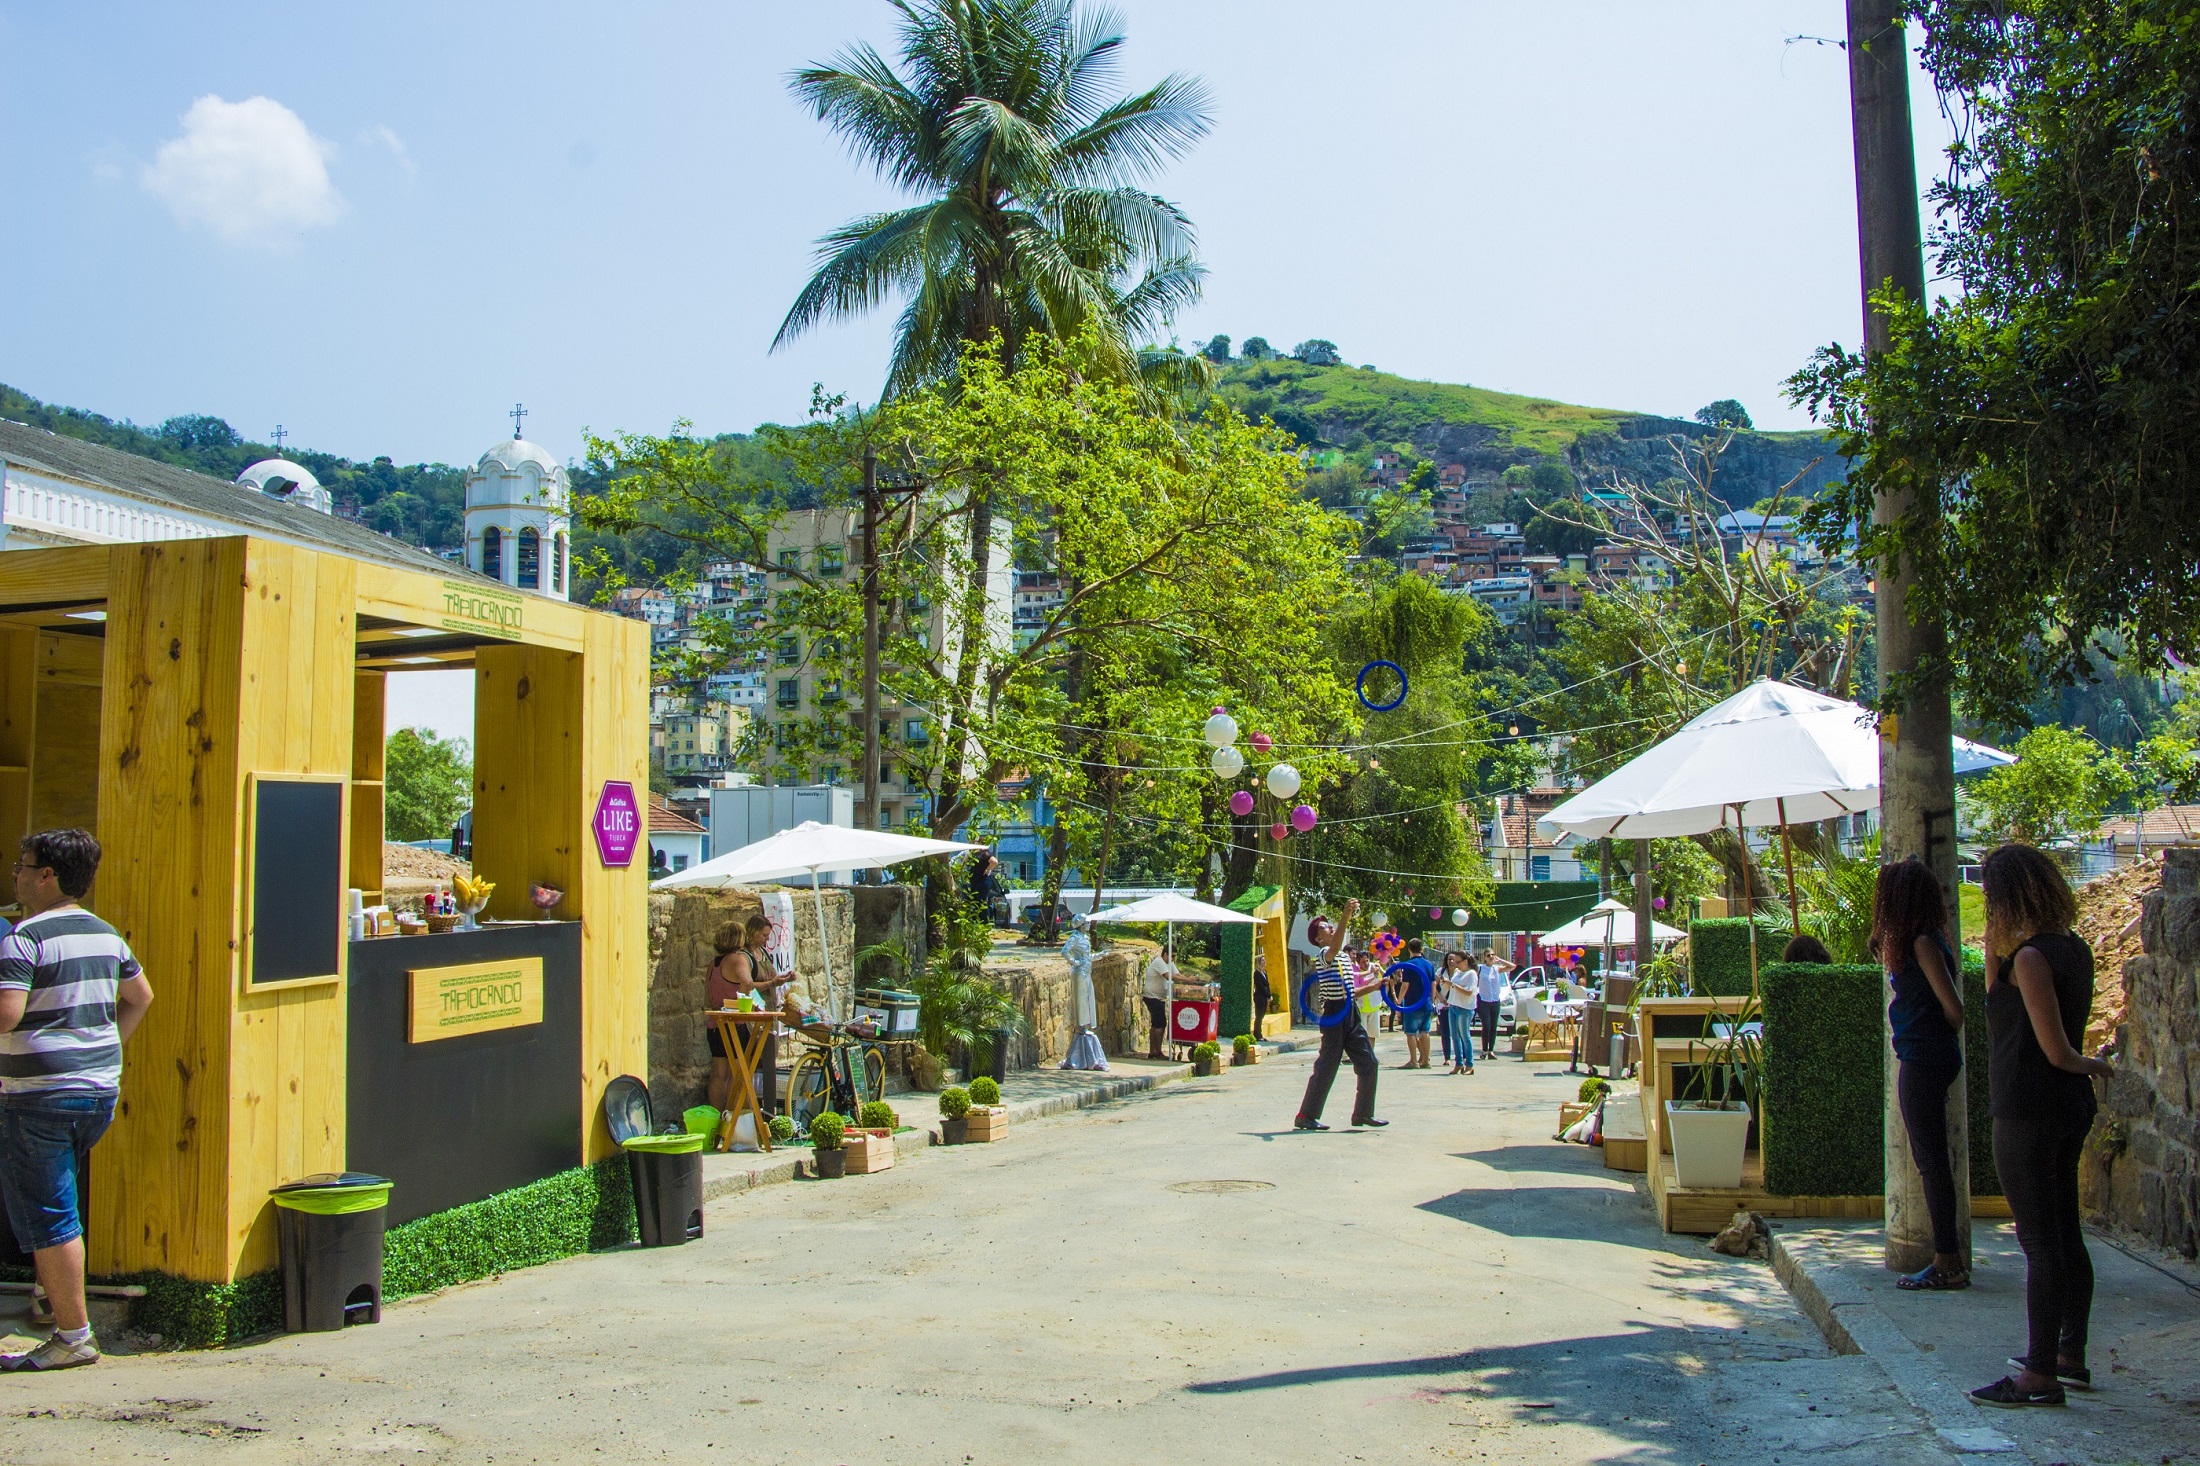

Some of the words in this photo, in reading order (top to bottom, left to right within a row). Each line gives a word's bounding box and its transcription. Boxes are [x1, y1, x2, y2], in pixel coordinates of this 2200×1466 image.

[443, 594, 522, 628] TAPIOCANDO
[602, 809, 634, 832] LIKE
[440, 982, 521, 1011] TAPIOCANDO
